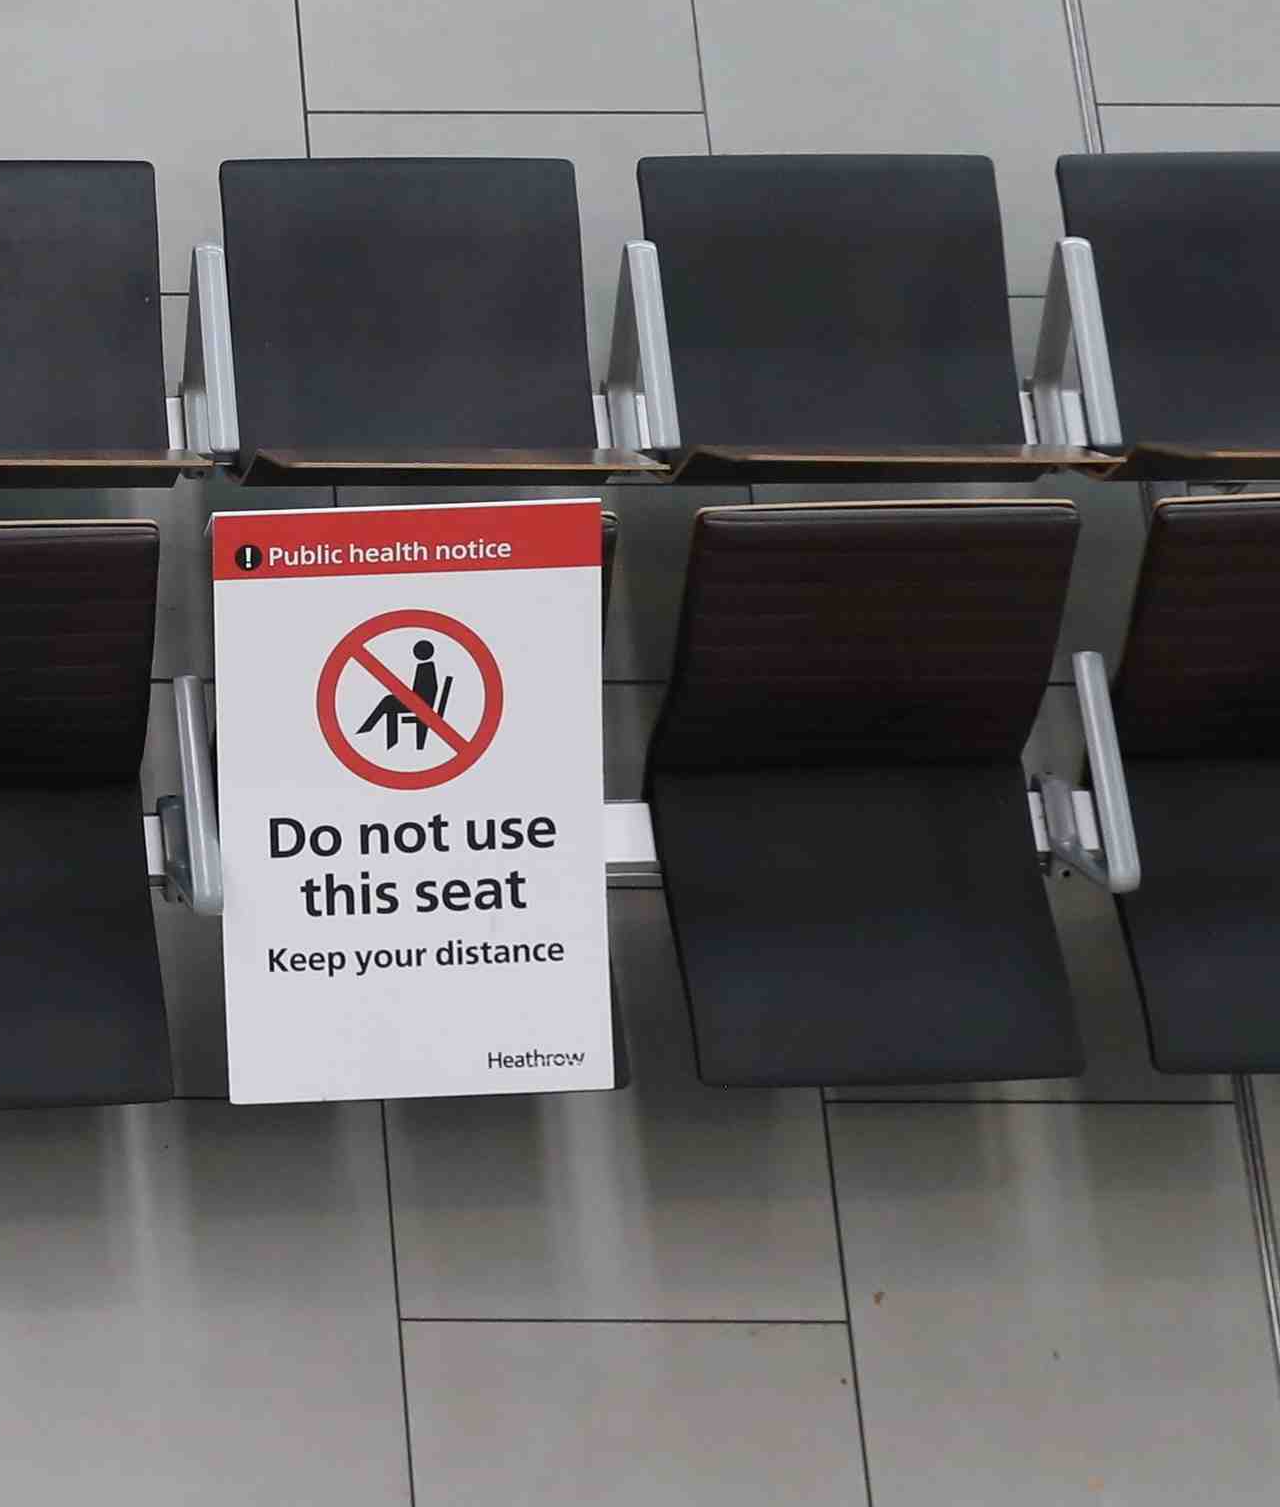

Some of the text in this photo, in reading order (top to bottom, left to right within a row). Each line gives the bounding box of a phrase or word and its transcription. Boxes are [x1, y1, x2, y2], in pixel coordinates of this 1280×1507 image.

[270, 539, 511, 565] Public health notice
[269, 814, 556, 858] Do not use
[300, 871, 527, 917] this seat
[269, 940, 564, 977] Keep your distance
[488, 1049, 585, 1069] Heathrow
